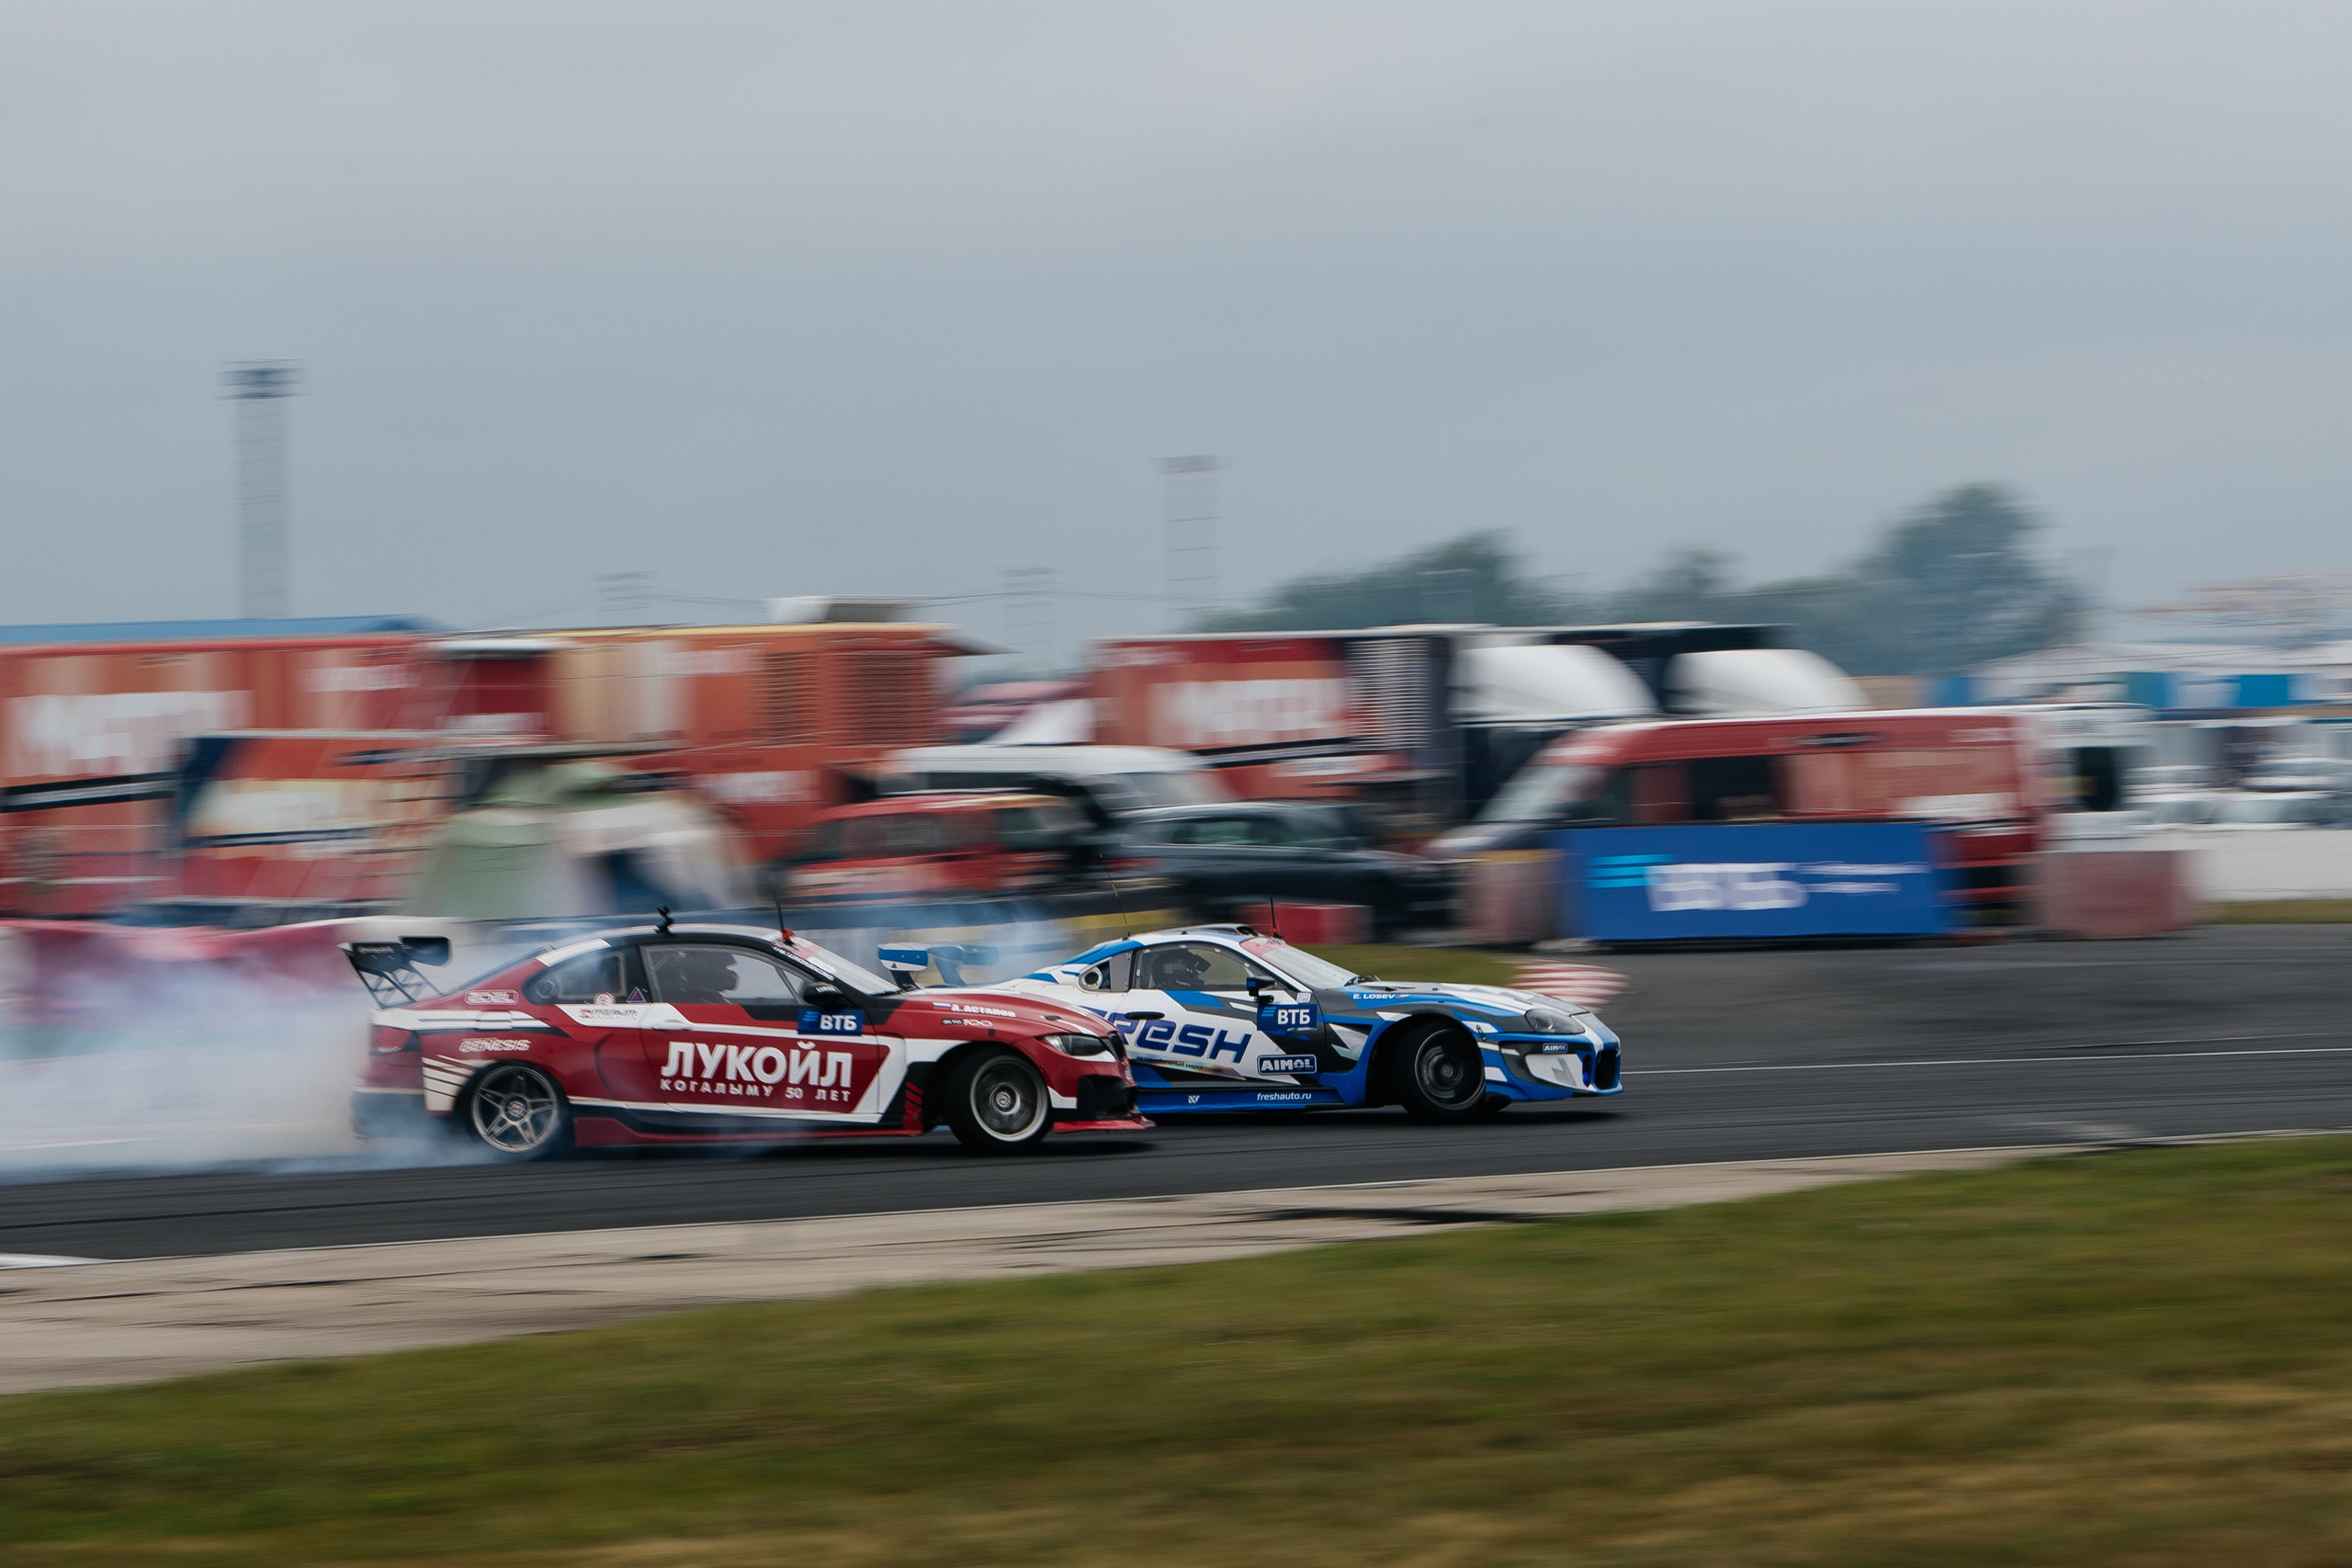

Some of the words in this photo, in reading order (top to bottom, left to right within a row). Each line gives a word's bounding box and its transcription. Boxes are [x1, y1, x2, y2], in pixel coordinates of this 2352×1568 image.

[820, 1014, 857, 1031] ВТБ
[1277, 1009, 1311, 1025] ВТБ
[458, 1037, 532, 1054] GENESIS
[661, 1041, 853, 1088] ЛУКОЙЛ
[1261, 1058, 1314, 1071] AIMOL
[660, 1078, 774, 1098] КОГАЛЫМУ
[785, 1087, 804, 1100] 50
[815, 1089, 851, 1102] ЛЕТ
[1257, 1091, 1312, 1101] freshauto.ru
